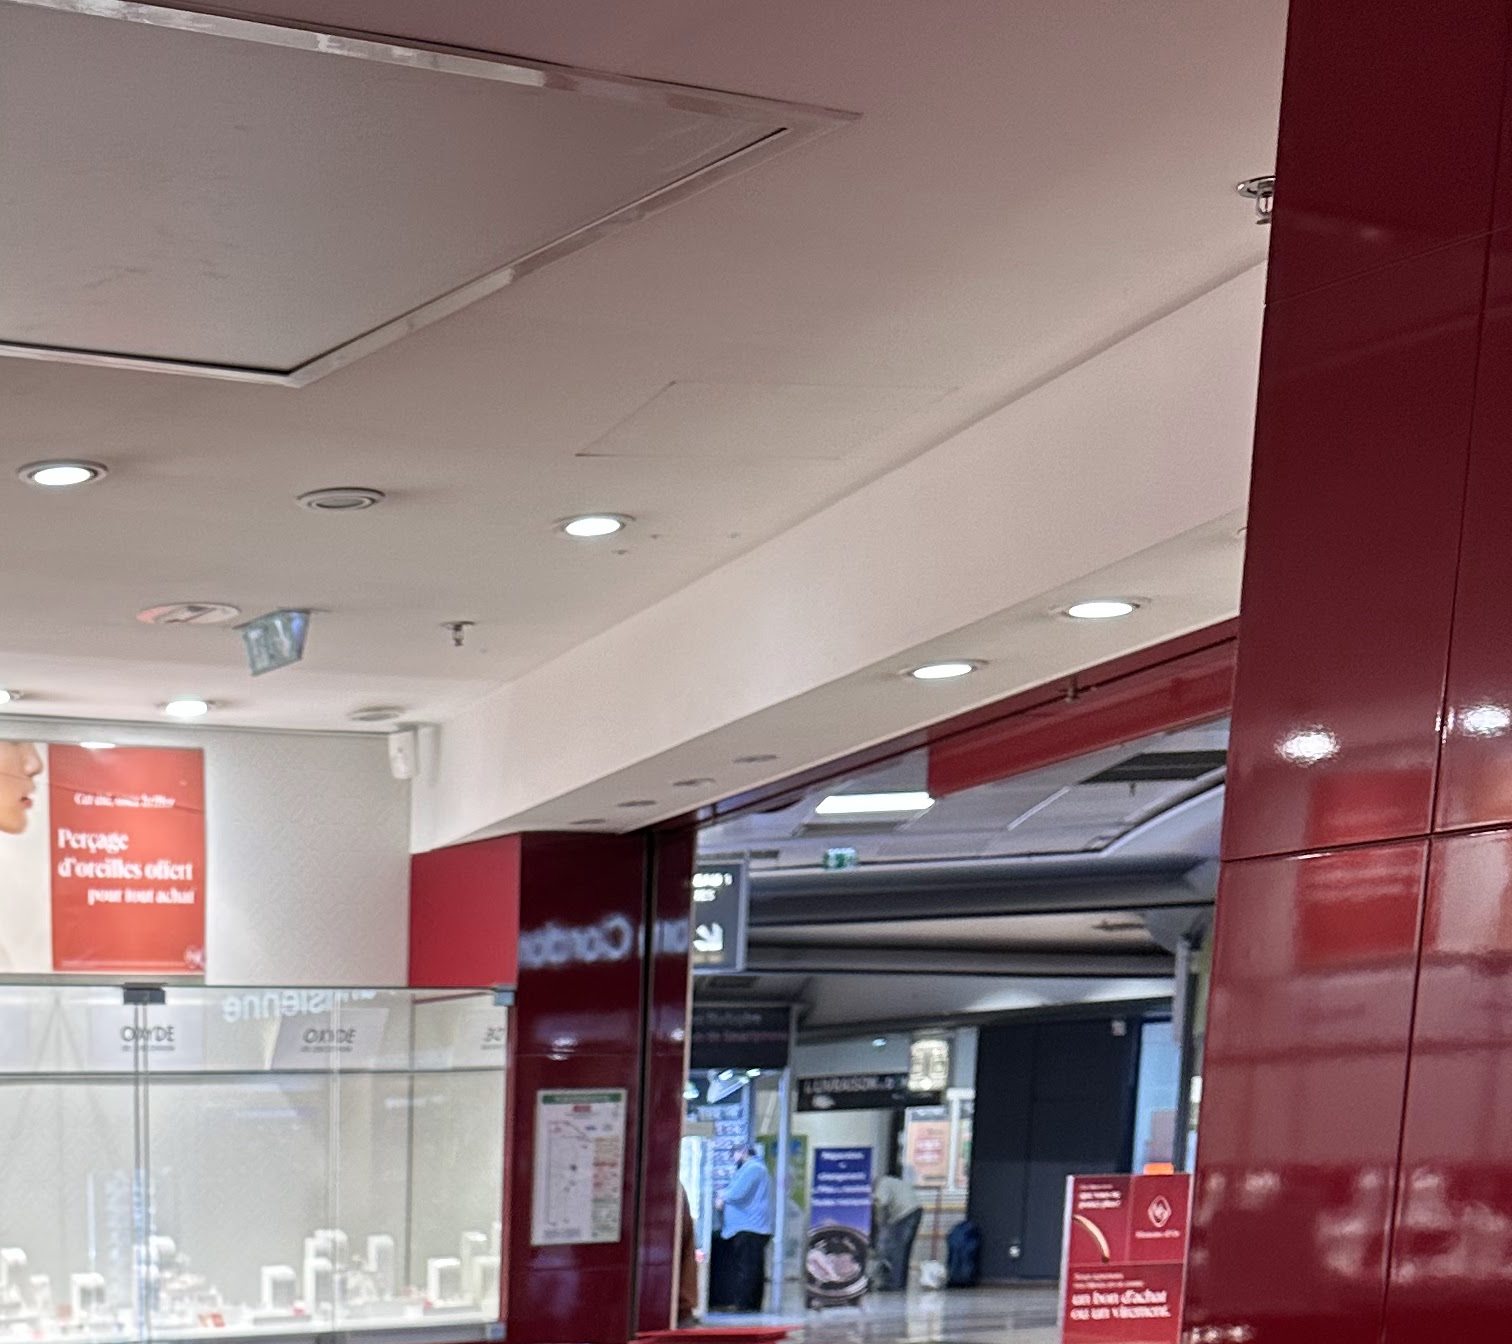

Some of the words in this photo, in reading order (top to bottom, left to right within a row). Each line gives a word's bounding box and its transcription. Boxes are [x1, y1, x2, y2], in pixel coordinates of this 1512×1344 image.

[57, 828, 129, 854] Perçage
[57, 857, 142, 880] d'oreilles
[144, 860, 193, 880] offert
[88, 888, 123, 905] pour
[125, 889, 153, 904] tout
[155, 887, 195, 904] achat
[1093, 1290, 1119, 1305] bon
